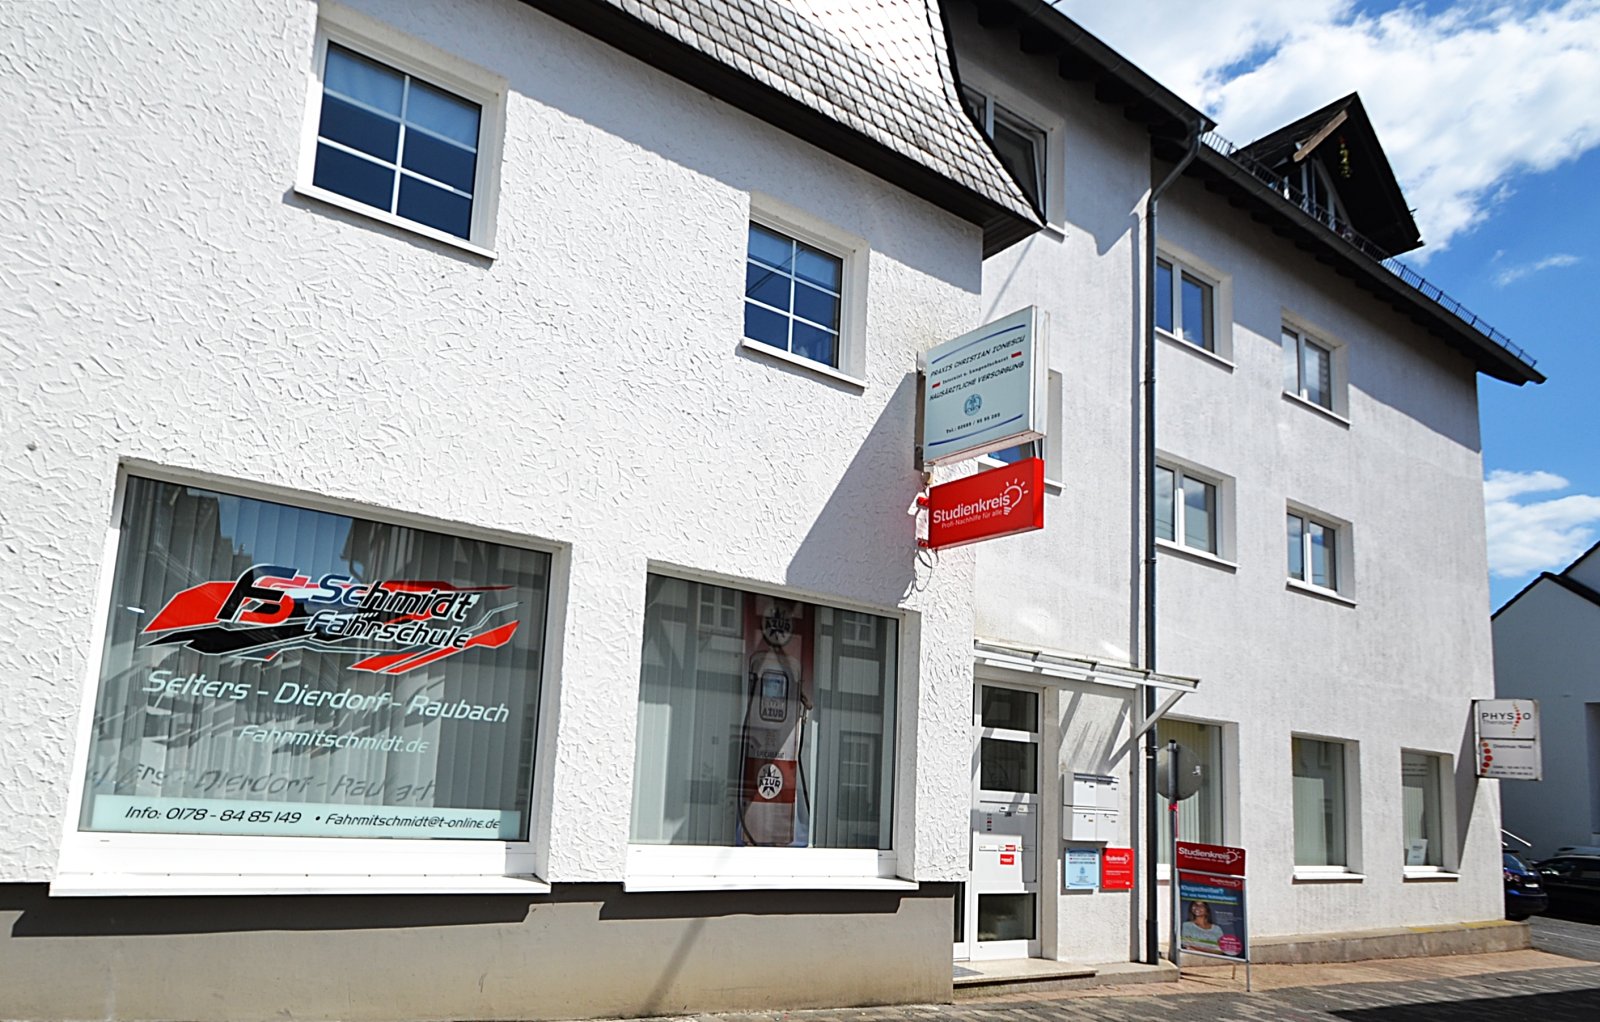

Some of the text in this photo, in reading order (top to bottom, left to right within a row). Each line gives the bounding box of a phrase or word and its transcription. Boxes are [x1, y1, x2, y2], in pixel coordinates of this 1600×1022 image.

[931, 335, 1026, 378] PRAXIS CHRISTIAN IONESCU
[977, 360, 1025, 383] VERSORGUNG
[933, 492, 1011, 524] Studienkreis
[941, 514, 982, 529] Profi-Nachhilfe
[982, 511, 991, 519] für
[309, 574, 474, 622] Schmidt
[304, 609, 472, 650] Fahrschule
[765, 619, 790, 632] AZUR
[142, 669, 252, 700] Selters
[273, 682, 391, 713] Dierdorf
[406, 694, 510, 723] Raubach
[762, 708, 784, 718] AZUR
[238, 725, 430, 754] Fahrmitschmidt.de
[758, 777, 781, 788] AZUR
[124, 805, 162, 819] Info:
[166, 807, 208, 821] 0178
[219, 809, 246, 822] 84
[247, 810, 273, 823] 85
[274, 811, 302, 824] 149
[325, 813, 501, 830] Fahrmitschmidt@t-online.de
[1178, 847, 1231, 860] Studienkreis
